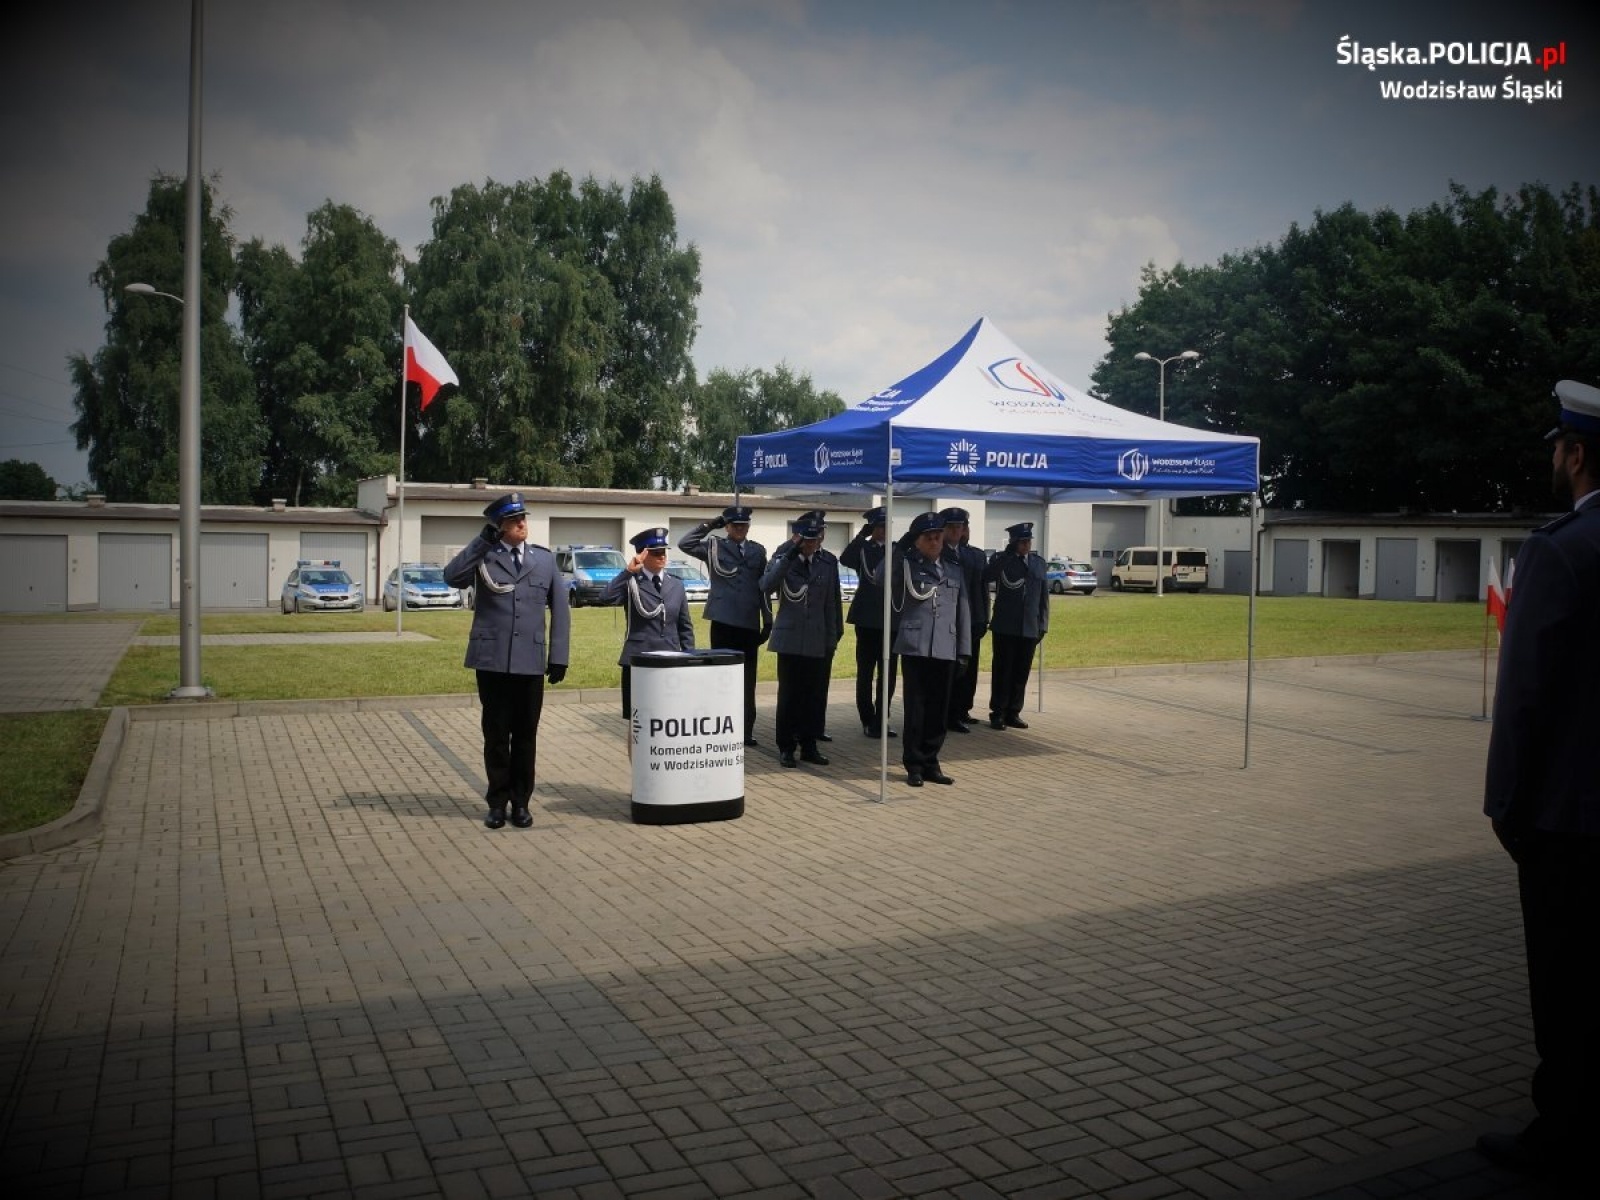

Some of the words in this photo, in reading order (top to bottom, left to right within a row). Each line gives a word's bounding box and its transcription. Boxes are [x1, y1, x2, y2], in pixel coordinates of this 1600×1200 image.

[765, 453, 788, 468] POLICJA
[986, 451, 1048, 469] POLICJA
[650, 716, 733, 737] POLICJA
[650, 744, 702, 756] Komenda
[650, 762, 661, 771] w
[664, 757, 733, 770] Wodzisławiu
